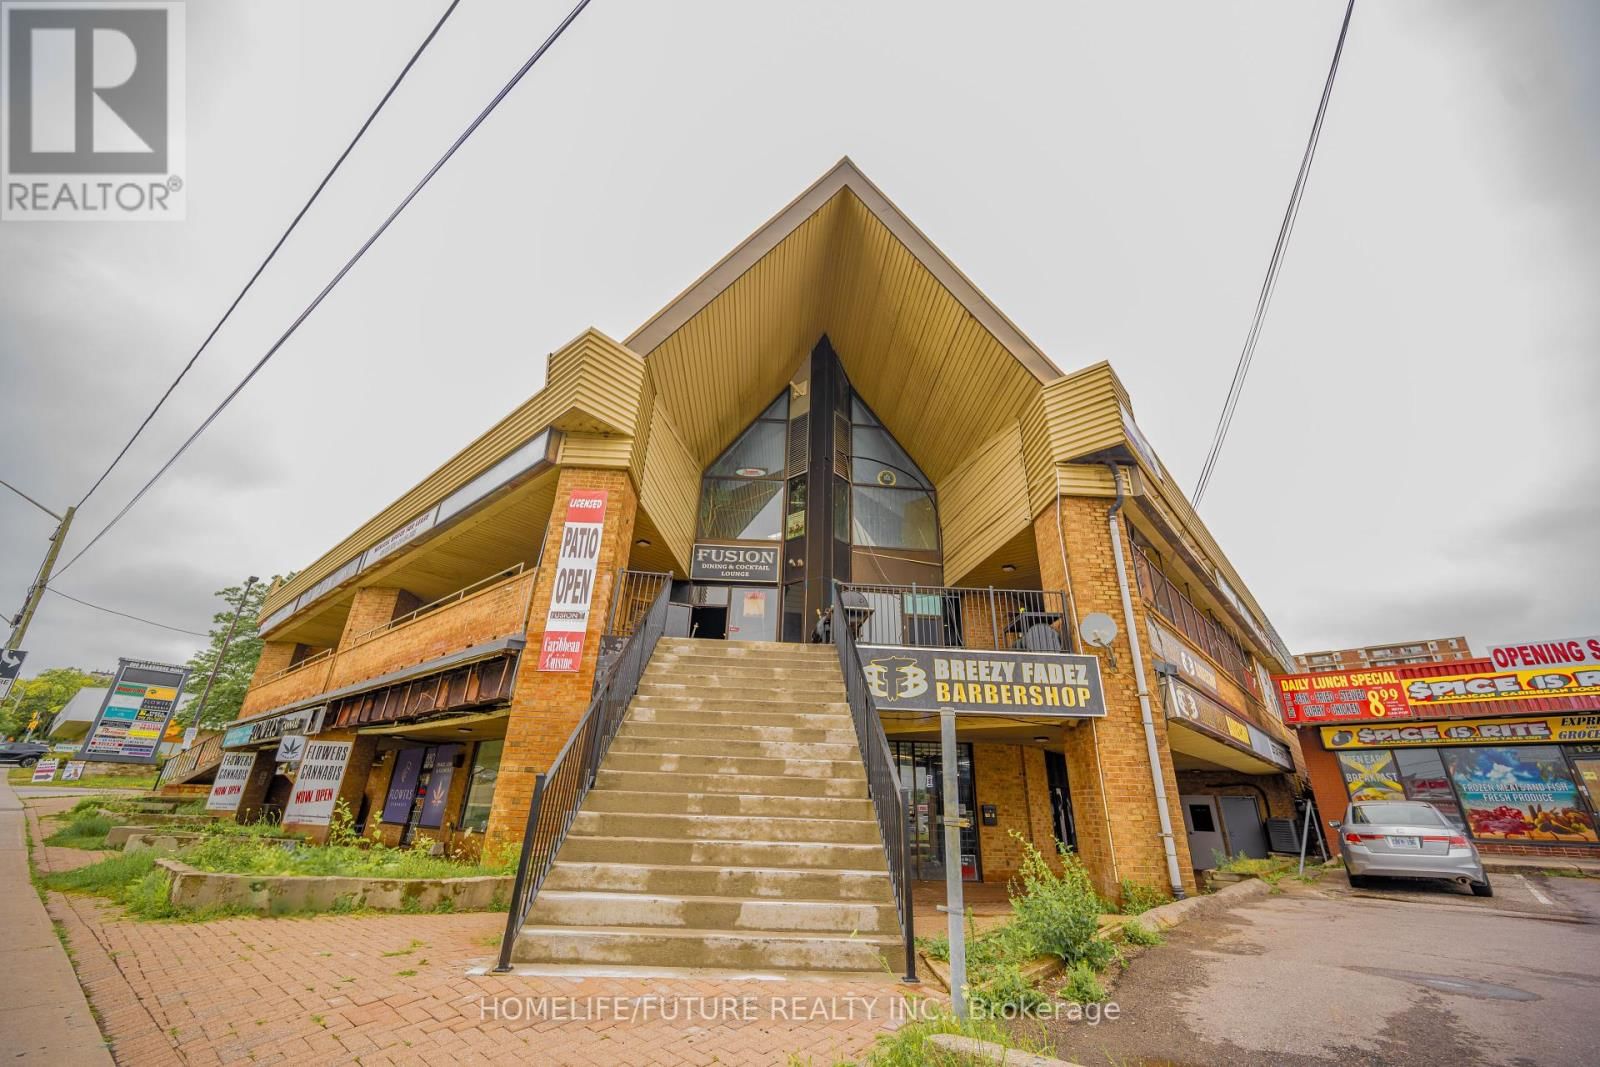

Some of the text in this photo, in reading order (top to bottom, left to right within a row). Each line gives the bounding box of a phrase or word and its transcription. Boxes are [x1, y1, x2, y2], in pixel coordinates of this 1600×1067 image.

[569, 498, 603, 509] LICENSED
[561, 526, 599, 560] PATIO
[696, 548, 775, 564] FUSION
[701, 562, 728, 570] DINING
[735, 563, 770, 571] COCKTAIL
[555, 567, 593, 605] OPEN
[543, 636, 581, 654] Caribbean
[1492, 640, 1586, 668] OPENING
[934, 658, 1089, 686] BREEZY FADEZ
[1281, 671, 1400, 692] DAILY LUNCH SPECIAL
[1533, 674, 1564, 690] IS
[936, 682, 1091, 708] BARBERSHOP
[1438, 692, 1495, 700] JAMAICAN
[1501, 688, 1570, 697] CARIBBEAN
[1449, 726, 1468, 738] IS
[1477, 722, 1550, 738] RITE
[306, 745, 349, 760] FLOWERS
[223, 755, 254, 767] FLOWERS
[218, 768, 249, 780] CANNABIS
[300, 764, 343, 780] CANNABIS
[1346, 772, 1398, 783] BREAKFAST
[214, 785, 241, 796] NOW OPEN
[1462, 783, 1495, 792] FROZEN
[1548, 782, 1569, 791] FISH
[295, 788, 333, 804] NOW OPEN
[1483, 793, 1554, 802] FRESH PRODUCE
